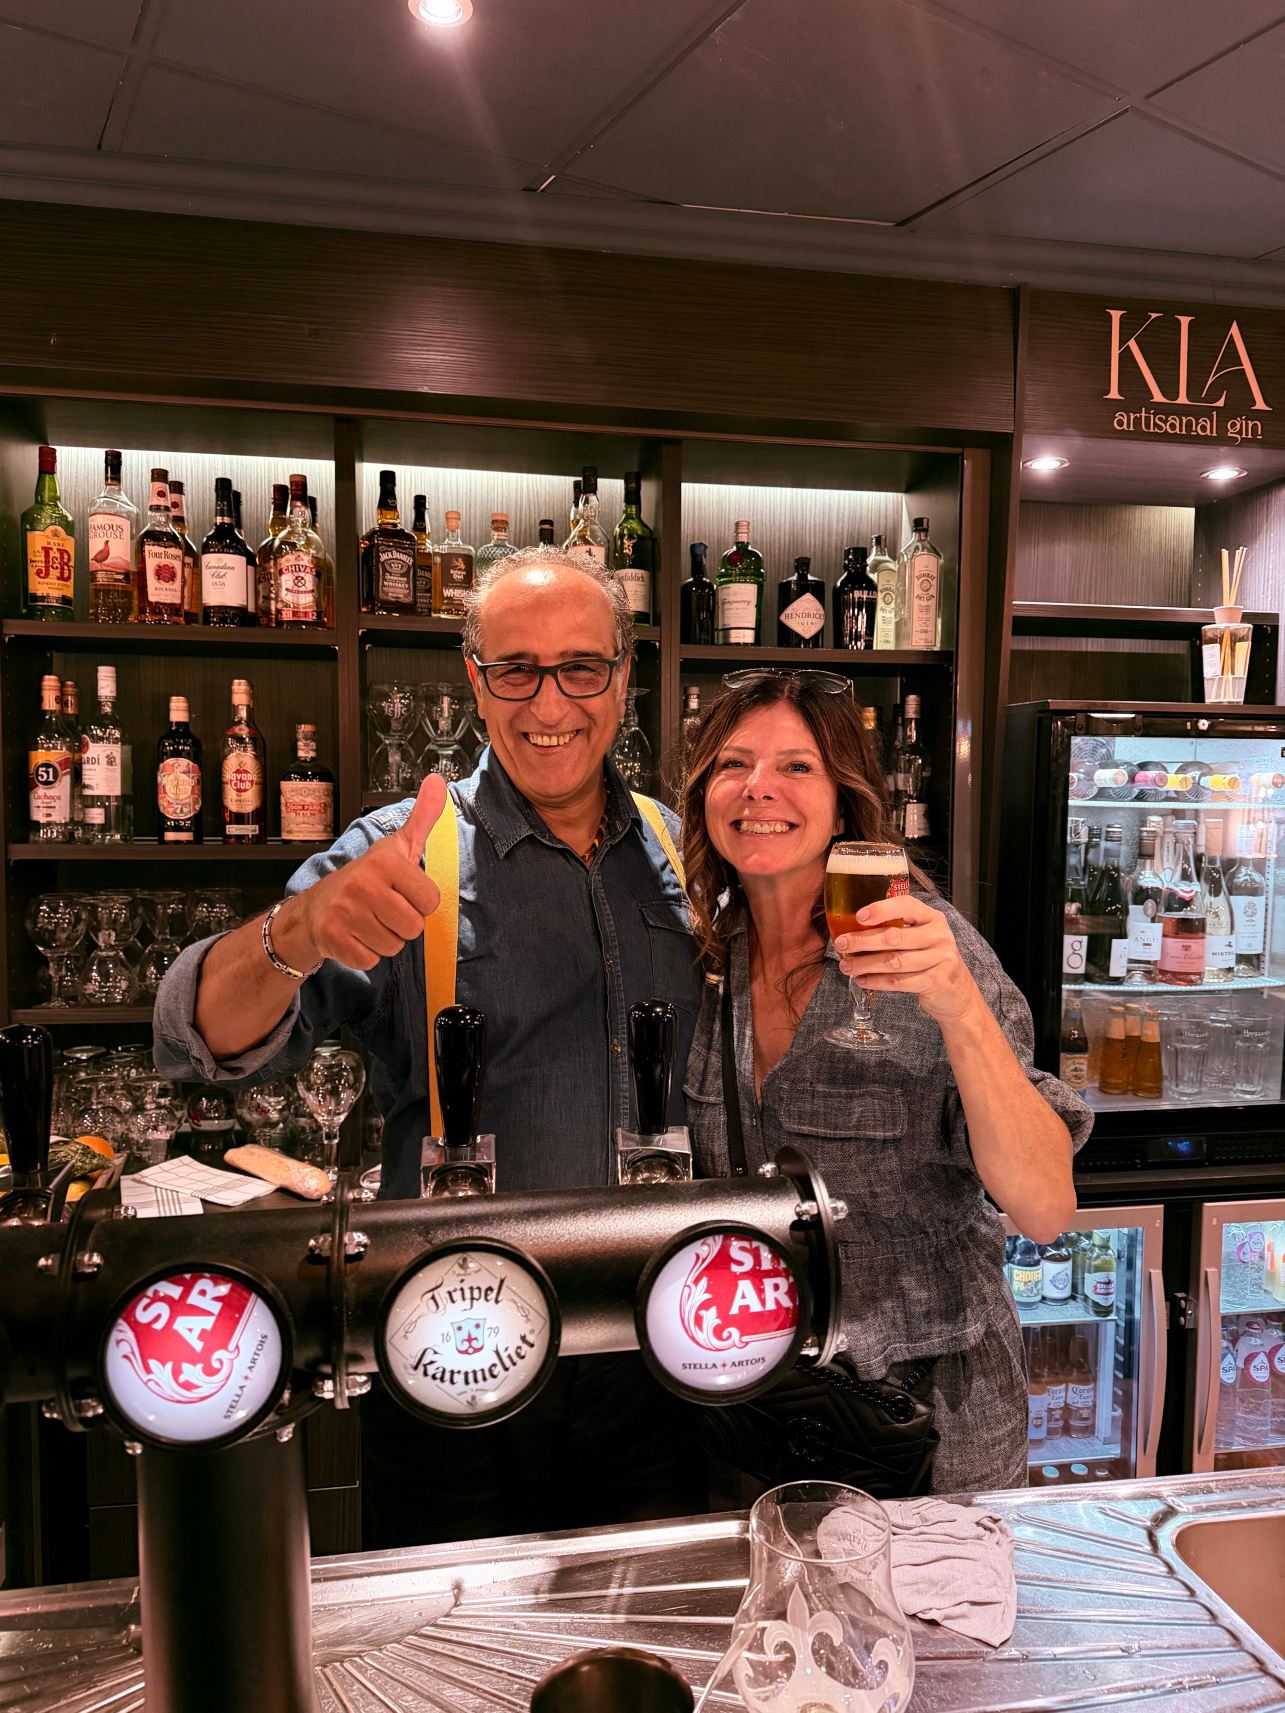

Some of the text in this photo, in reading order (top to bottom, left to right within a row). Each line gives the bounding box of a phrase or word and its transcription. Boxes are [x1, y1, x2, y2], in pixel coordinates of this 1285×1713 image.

[1113, 406, 1263, 446] artisanal gin
[148, 549, 182, 561] Four Roses
[282, 565, 317, 576] CHIVAS
[443, 588, 471, 598] WHISK
[38, 767, 55, 782] 51
[226, 772, 257, 781] Havana
[231, 780, 252, 789] Club
[420, 1275, 508, 1316] Tripel
[729, 1276, 794, 1315] AR
[172, 1277, 232, 1353] AR
[441, 1326, 501, 1343] 16 79
[409, 1334, 535, 1387] Karmeliet
[682, 1357, 766, 1371] STELLA ARTOIS
[224, 1333, 268, 1420] STELLA ARTOIS
